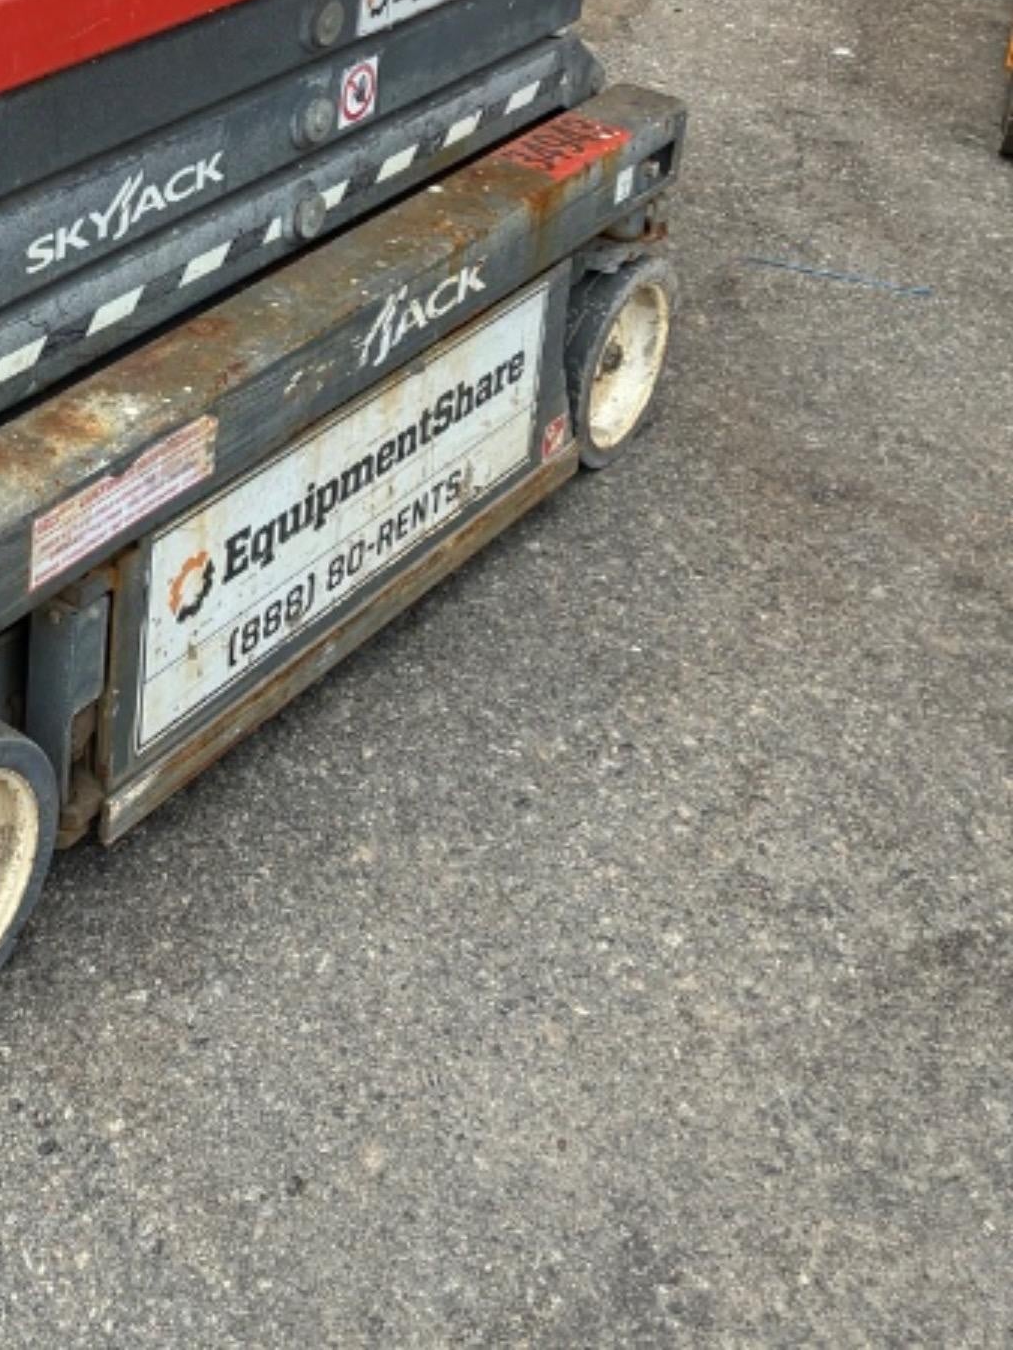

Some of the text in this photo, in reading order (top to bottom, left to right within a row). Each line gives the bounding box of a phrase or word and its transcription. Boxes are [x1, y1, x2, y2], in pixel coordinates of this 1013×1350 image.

[25, 150, 225, 274] SKYJACK
[221, 351, 525, 584] EquipmentShare
[227, 573, 317, 667] (888)
[326, 471, 463, 591] 80-RENTS
